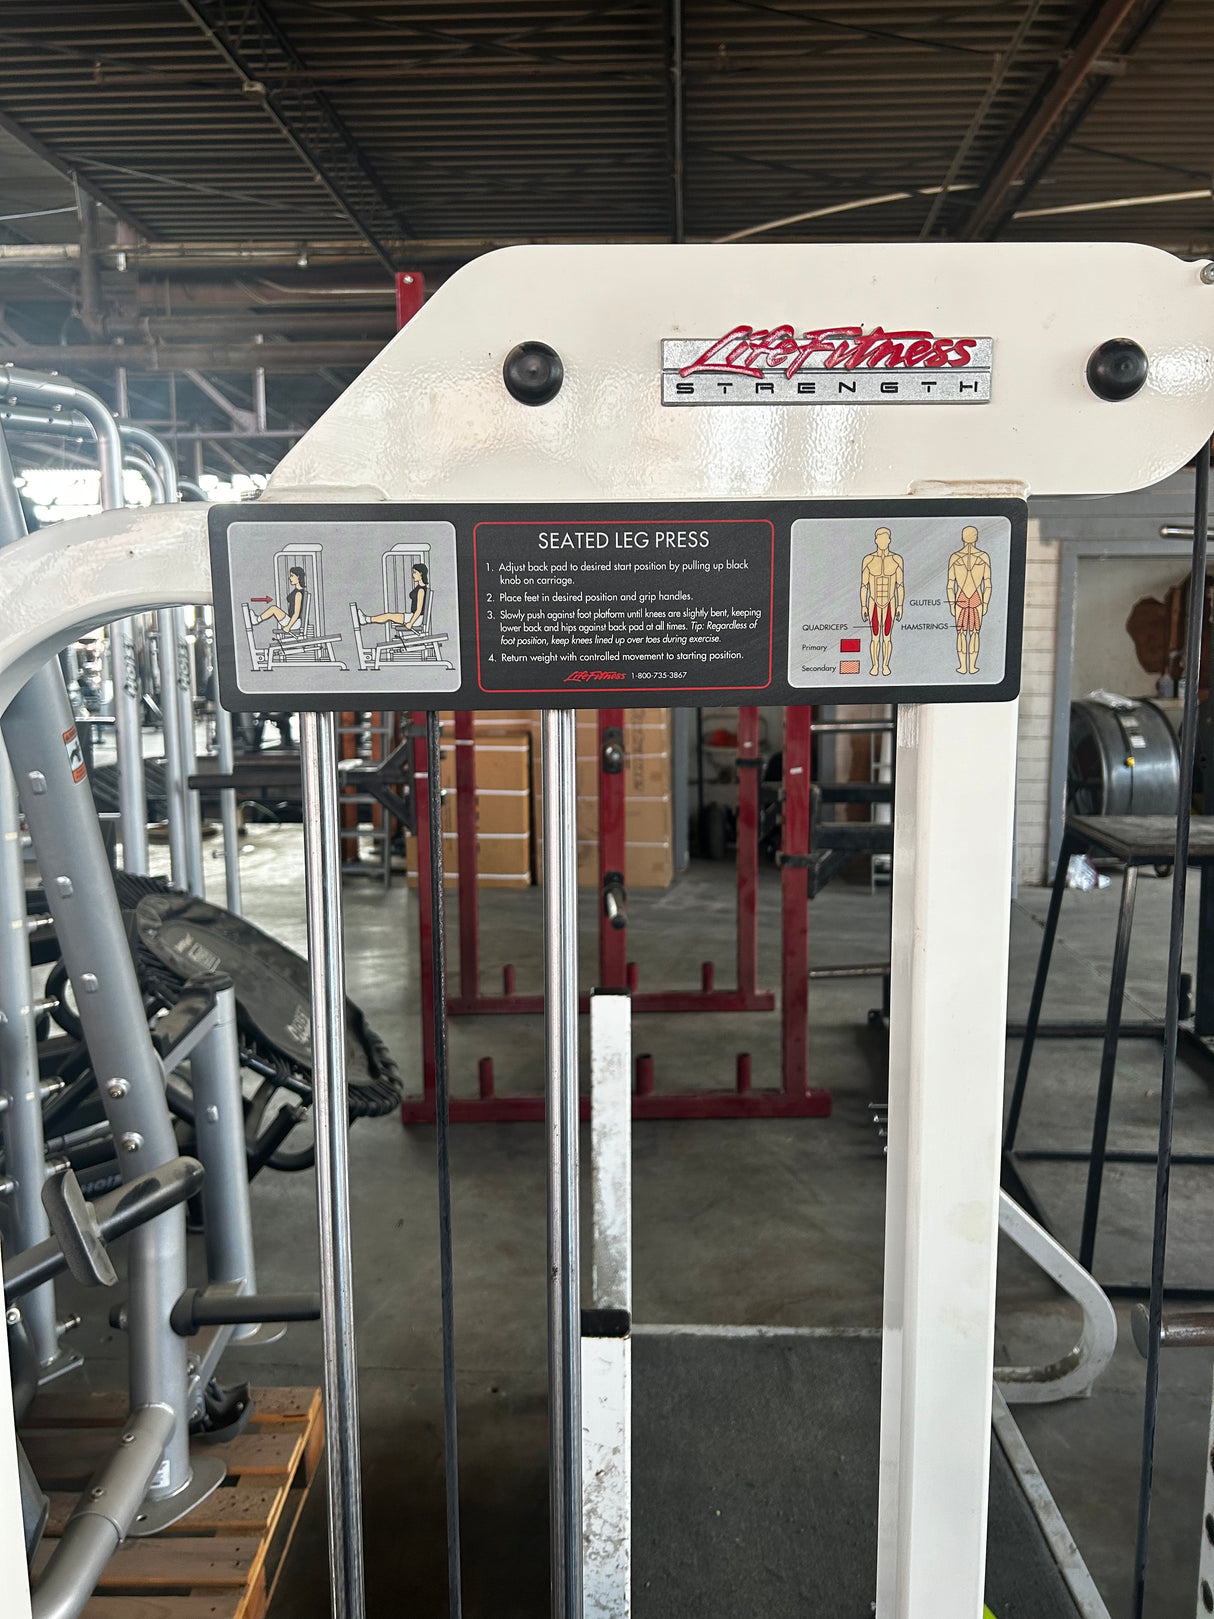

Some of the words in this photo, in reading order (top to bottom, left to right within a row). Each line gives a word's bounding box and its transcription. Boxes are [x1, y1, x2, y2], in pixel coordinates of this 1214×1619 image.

[676, 381, 978, 394] STRENGTH
[538, 532, 609, 549] SEATED
[615, 531, 650, 549] LEG
[655, 530, 710, 548] PRESS
[486, 563, 493, 571] 1.
[499, 562, 525, 574] Adjust
[528, 561, 548, 571] back
[551, 561, 567, 573] pad
[581, 561, 611, 571] desired
[634, 562, 666, 573] position
[669, 560, 680, 572] by
[682, 560, 710, 572] pulling
[727, 559, 748, 569] black
[500, 575, 521, 584] knob
[537, 576, 574, 586] carriage.
[487, 593, 494, 602] 2.
[500, 592, 522, 602] Place
[525, 592, 539, 602] feet
[542, 593, 549, 601] in
[552, 592, 582, 601] desired
[586, 593, 617, 603] position
[620, 591, 636, 601] and
[639, 592, 656, 603] grip
[659, 591, 693, 600] handles.
[487, 610, 495, 619] 3.
[500, 610, 525, 621] Slowly
[527, 609, 545, 621] push
[547, 610, 575, 621] against
[577, 609, 591, 618] foot
[594, 608, 624, 621] platform
[627, 608, 642, 618] until
[645, 608, 666, 617] knees
[683, 607, 708, 619] slightly
[711, 607, 729, 618] bent,
[732, 607, 761, 618] keeping
[500, 623, 521, 632] lower
[523, 622, 542, 632] back
[544, 622, 559, 631] and
[561, 622, 577, 634] hips
[579, 623, 606, 634] against
[608, 621, 626, 631] back
[629, 621, 644, 633] pad
[655, 621, 664, 630] all
[667, 622, 687, 630] times.
[691, 621, 704, 632] Tip:
[707, 620, 747, 632] Regardless
[749, 619, 757, 629] of
[501, 635, 515, 645] foot
[517, 636, 548, 647] position,
[551, 635, 569, 646] keep
[571, 635, 592, 644] knees
[595, 634, 613, 644] lined
[615, 638, 625, 646] up
[662, 634, 687, 645] during
[689, 634, 721, 642] exercise.
[802, 644, 827, 652] Primary
[488, 654, 496, 662] 4.
[502, 653, 527, 662] Return
[530, 652, 558, 664] weight
[560, 652, 577, 661] with
[580, 651, 619, 661] controlled
[677, 651, 706, 662] starting
[710, 651, 743, 661] position.
[631, 671, 688, 680] 1-800-735-3867
[802, 665, 836, 673] Secondary
